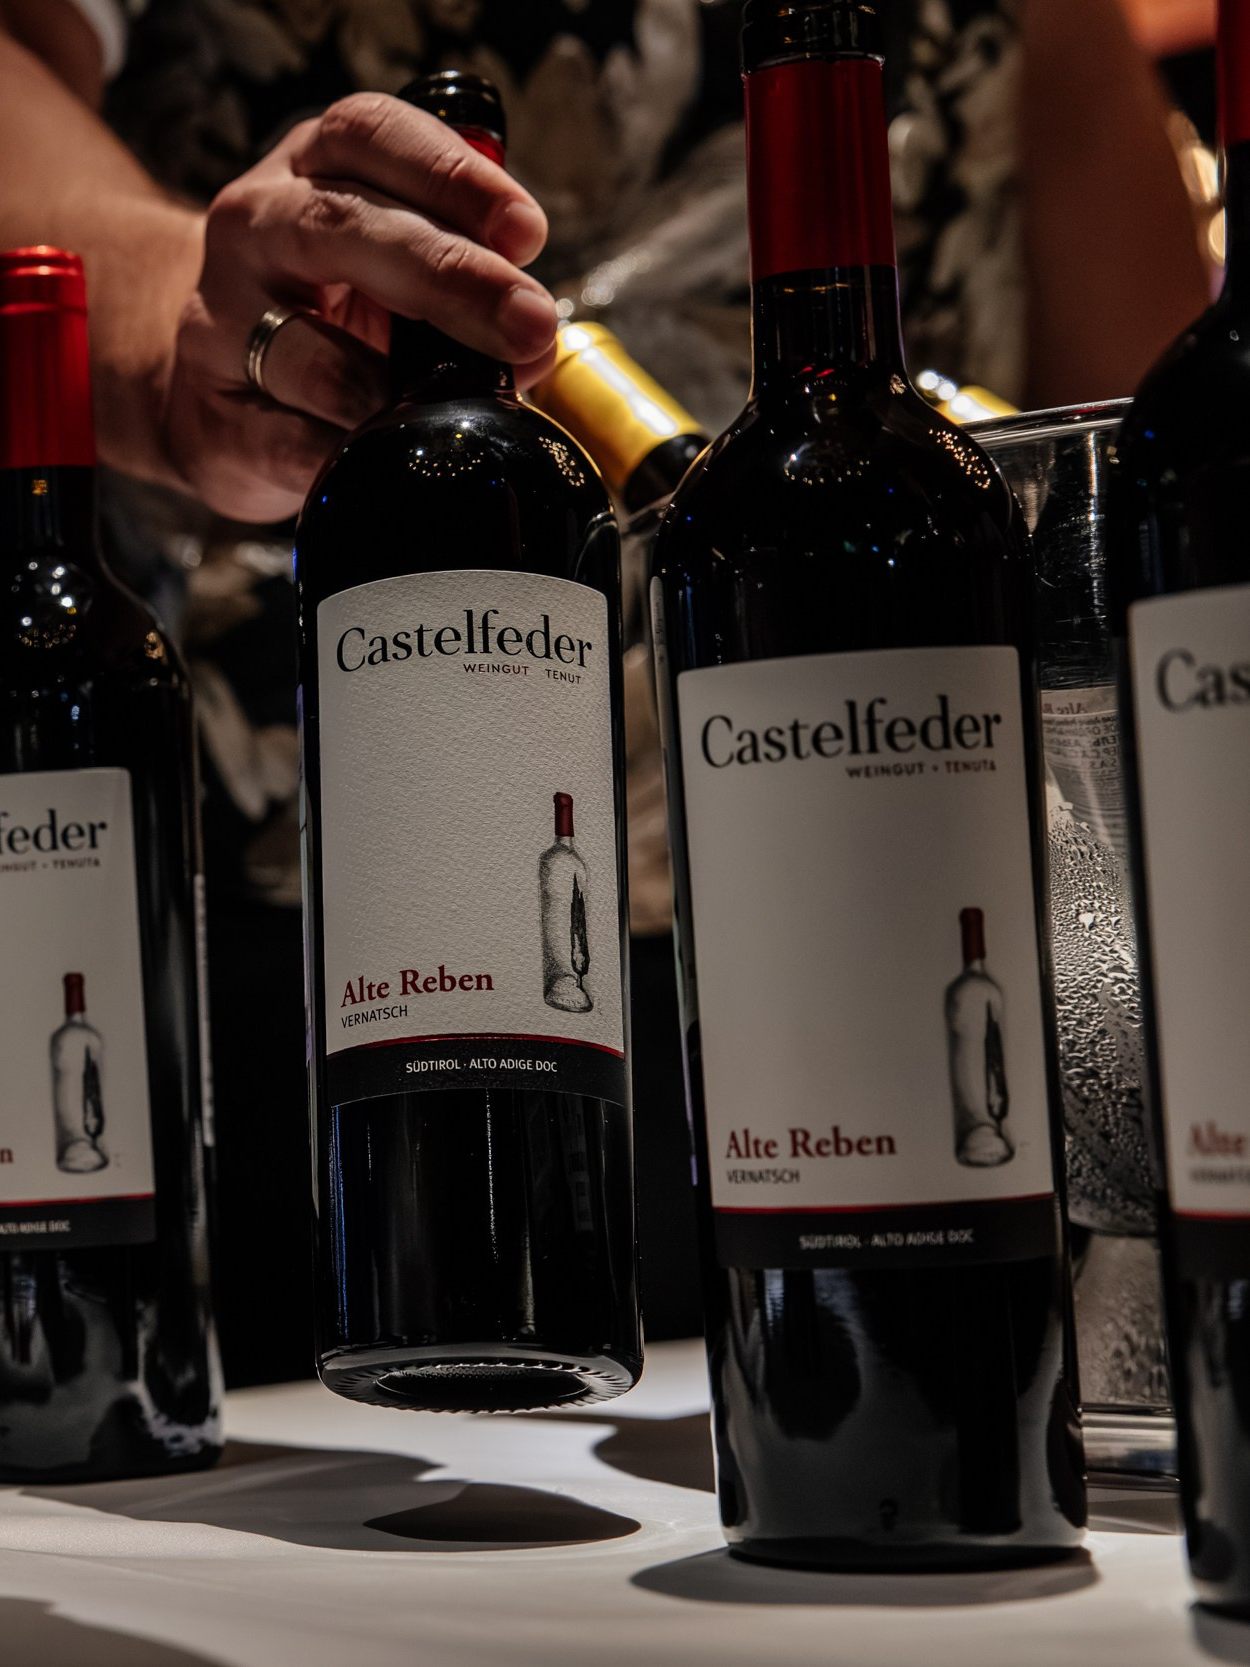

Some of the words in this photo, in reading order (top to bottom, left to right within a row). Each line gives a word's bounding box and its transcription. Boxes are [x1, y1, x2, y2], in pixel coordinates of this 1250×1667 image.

[336, 609, 592, 672] Castelfeder
[463, 663, 529, 676] WEINGUT
[701, 694, 1002, 769] Castelfeder
[846, 762, 925, 779] WEINGUT
[945, 759, 997, 774] TENUTA
[52, 857, 100, 870] TENUTA
[341, 975, 390, 1008] Alte
[399, 964, 494, 996] Reben
[341, 1005, 408, 1029] VERNATSCH
[406, 1059, 461, 1073] SÜDTIROL
[469, 1058, 496, 1070] ALTO
[500, 1058, 533, 1071] ADIGE
[535, 1060, 558, 1072] DOC
[726, 1128, 779, 1159] Alte
[788, 1125, 896, 1159] Reben
[726, 1168, 800, 1184] VERNATSCH
